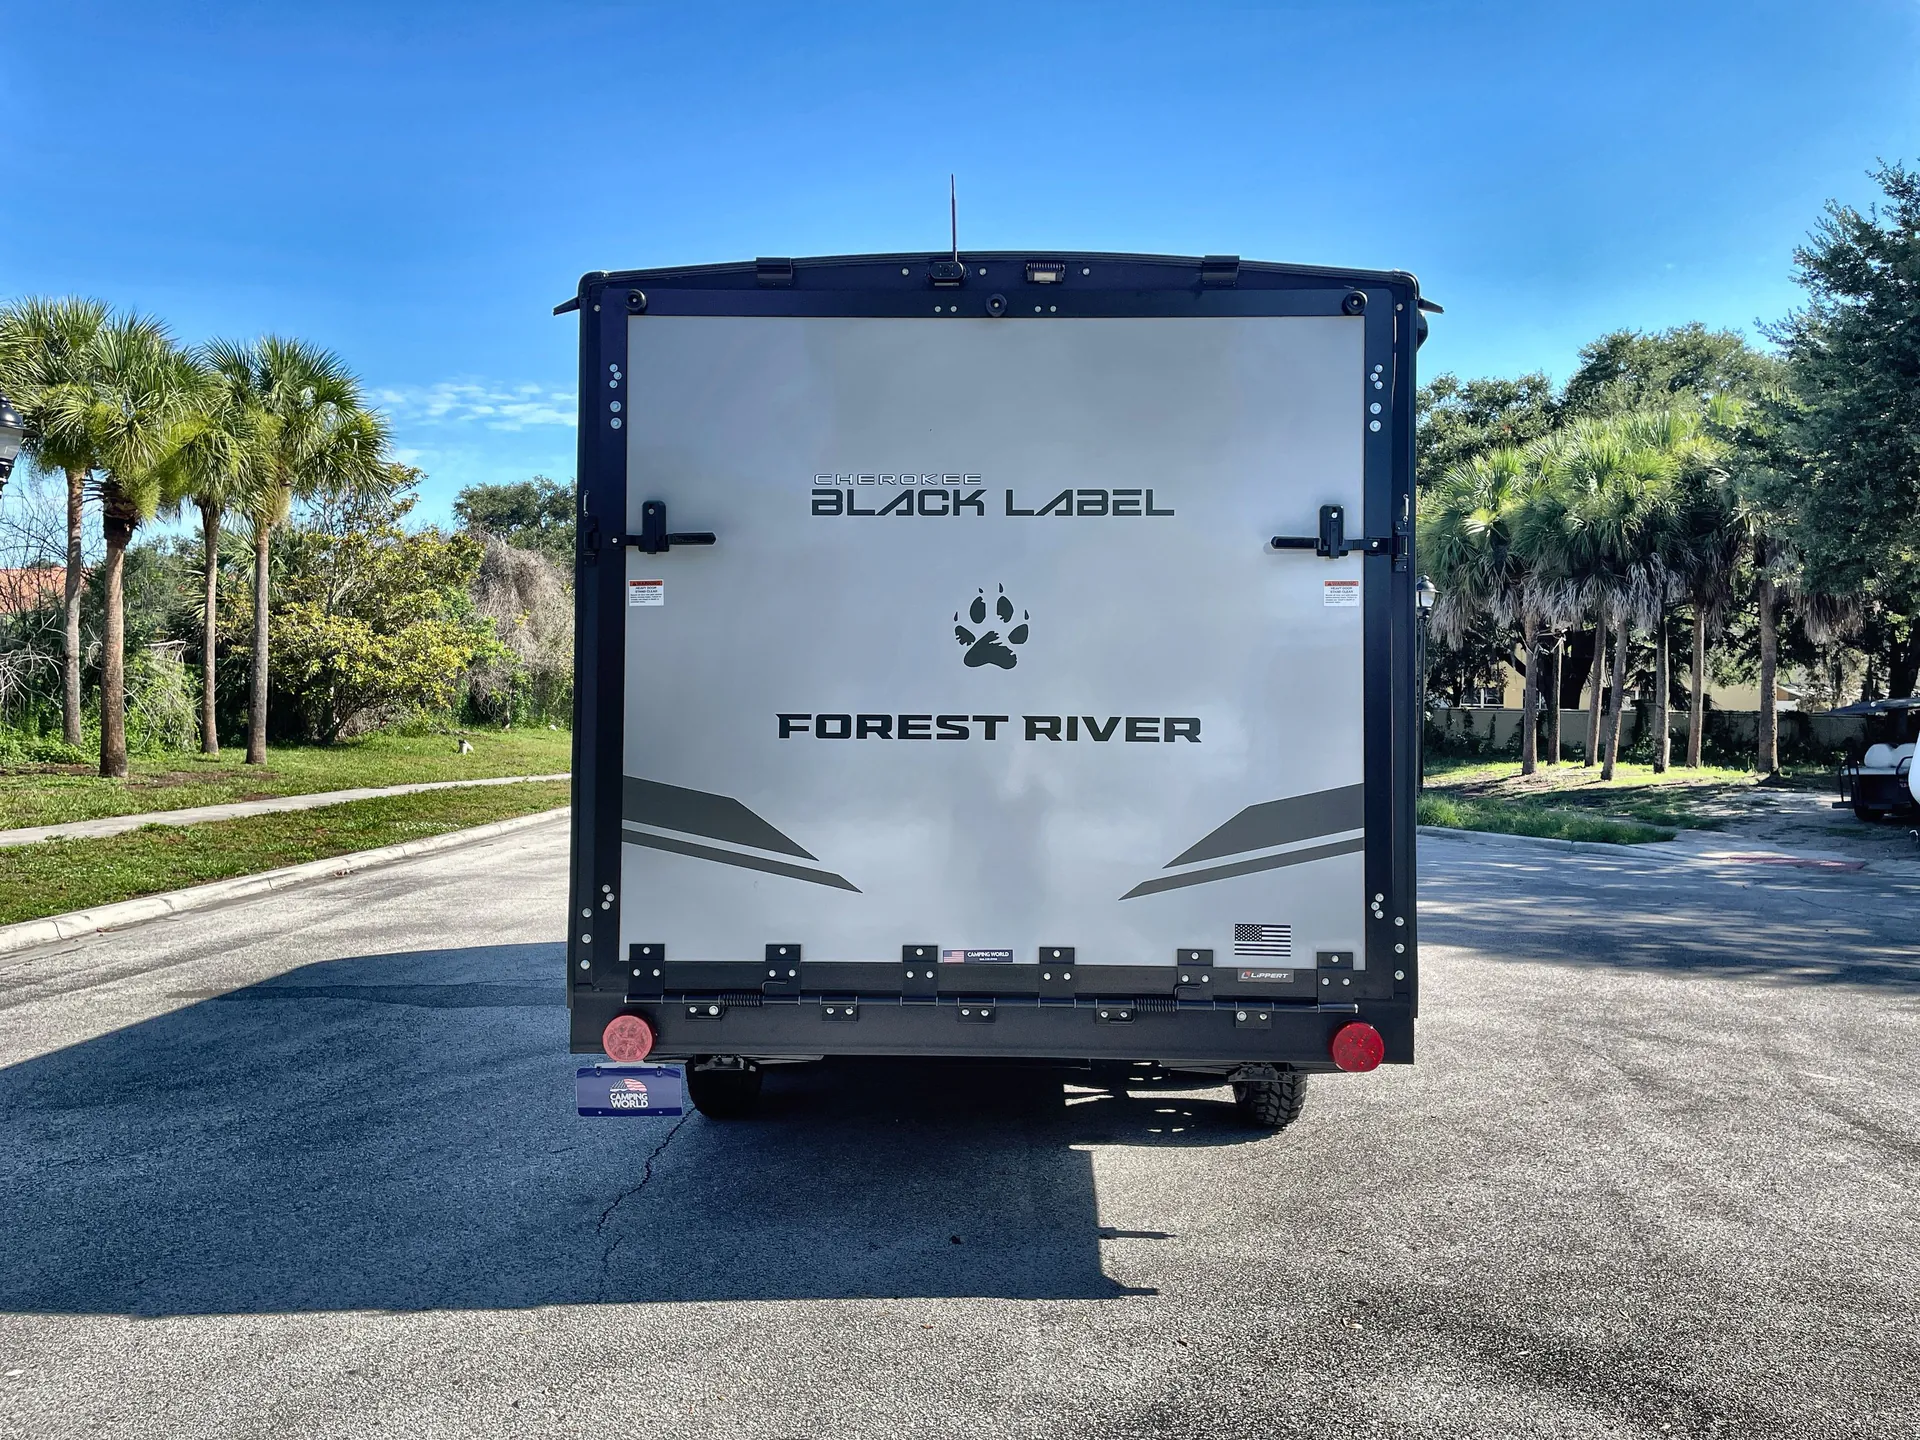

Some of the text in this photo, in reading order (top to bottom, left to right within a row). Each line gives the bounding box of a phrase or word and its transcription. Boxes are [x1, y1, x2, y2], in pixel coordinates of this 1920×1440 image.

[813, 473, 982, 486] CHEROKEE
[811, 488, 1175, 517] BLACK LABEL
[775, 713, 1202, 743] FOREST RIVER
[609, 1093, 648, 1101] CAMPING
[610, 1100, 649, 1108] WORLD
